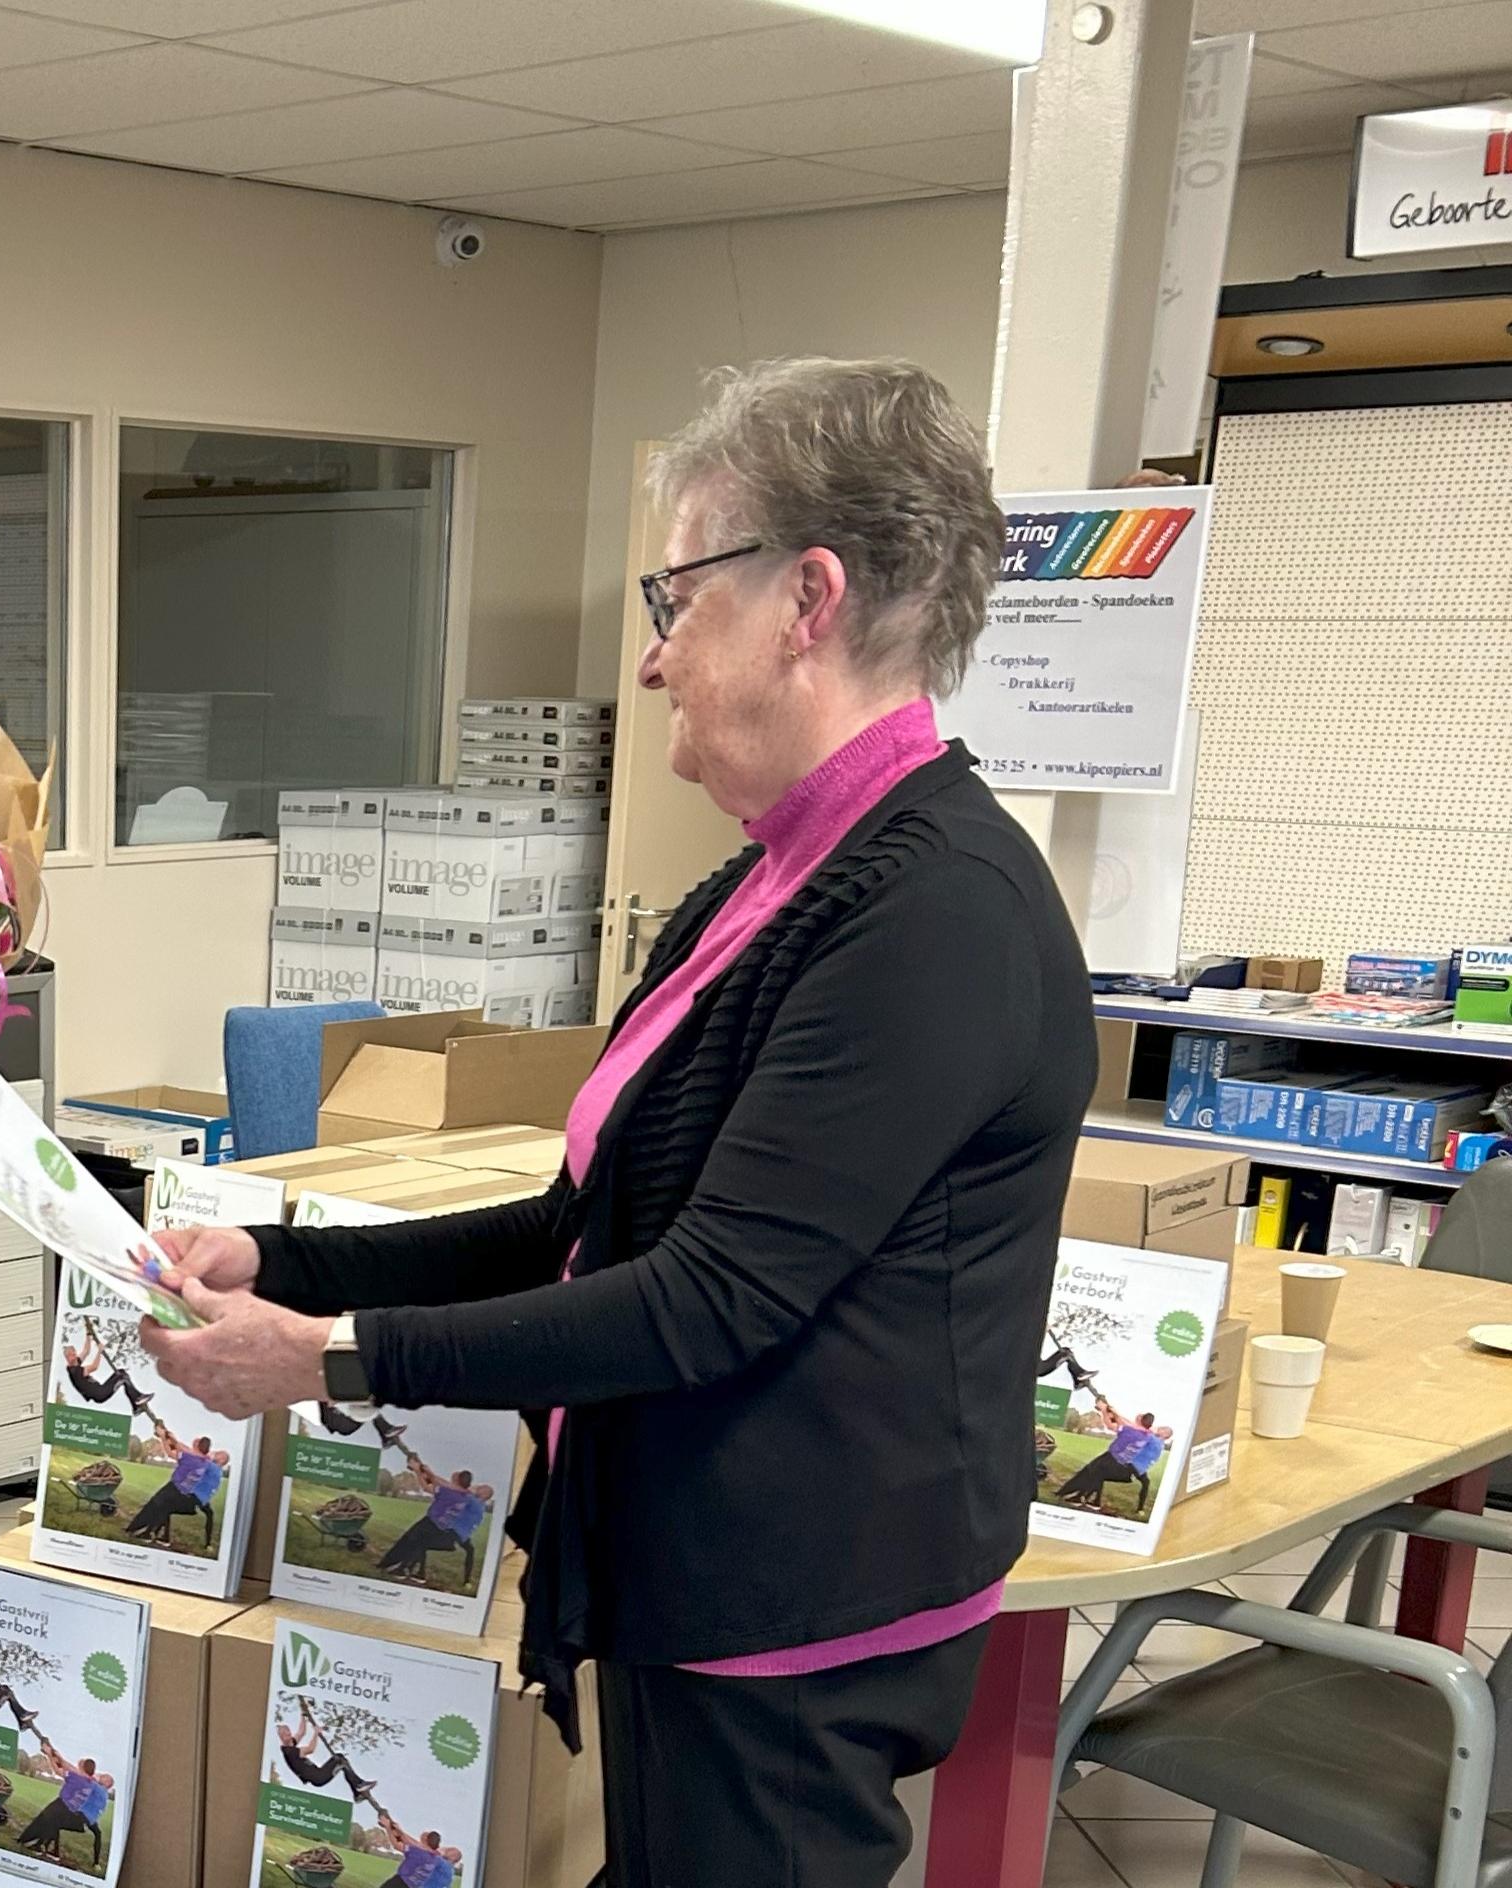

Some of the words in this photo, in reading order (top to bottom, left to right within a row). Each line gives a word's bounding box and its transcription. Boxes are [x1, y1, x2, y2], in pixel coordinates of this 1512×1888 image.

[1005, 519, 1059, 548] ering
[988, 595, 1079, 608] eclameborden
[1090, 593, 1175, 610] Spandoeken
[996, 611, 1021, 624] veel
[990, 653, 1050, 669] Copyshop
[1008, 676, 1076, 692] Drukkerij
[1027, 700, 1134, 714] Kantoorartikelen
[992, 759, 1007, 772] 25
[1010, 759, 1026, 773] 25
[1044, 762, 1163, 778] www.kipcopiers.nl
[283, 844, 376, 887] image
[389, 851, 487, 896] image
[283, 875, 322, 887] VOLUME
[388, 883, 430, 896] VOLUME
[276, 959, 367, 1001] image
[382, 967, 478, 1010] image
[275, 990, 315, 1002] VOLUME
[380, 999, 421, 1012] VOLUME
[1072, 1266, 1128, 1288] Gastvrij
[1056, 1281, 1124, 1301] sterbork
[333, 1660, 392, 1687] Gastvrij
